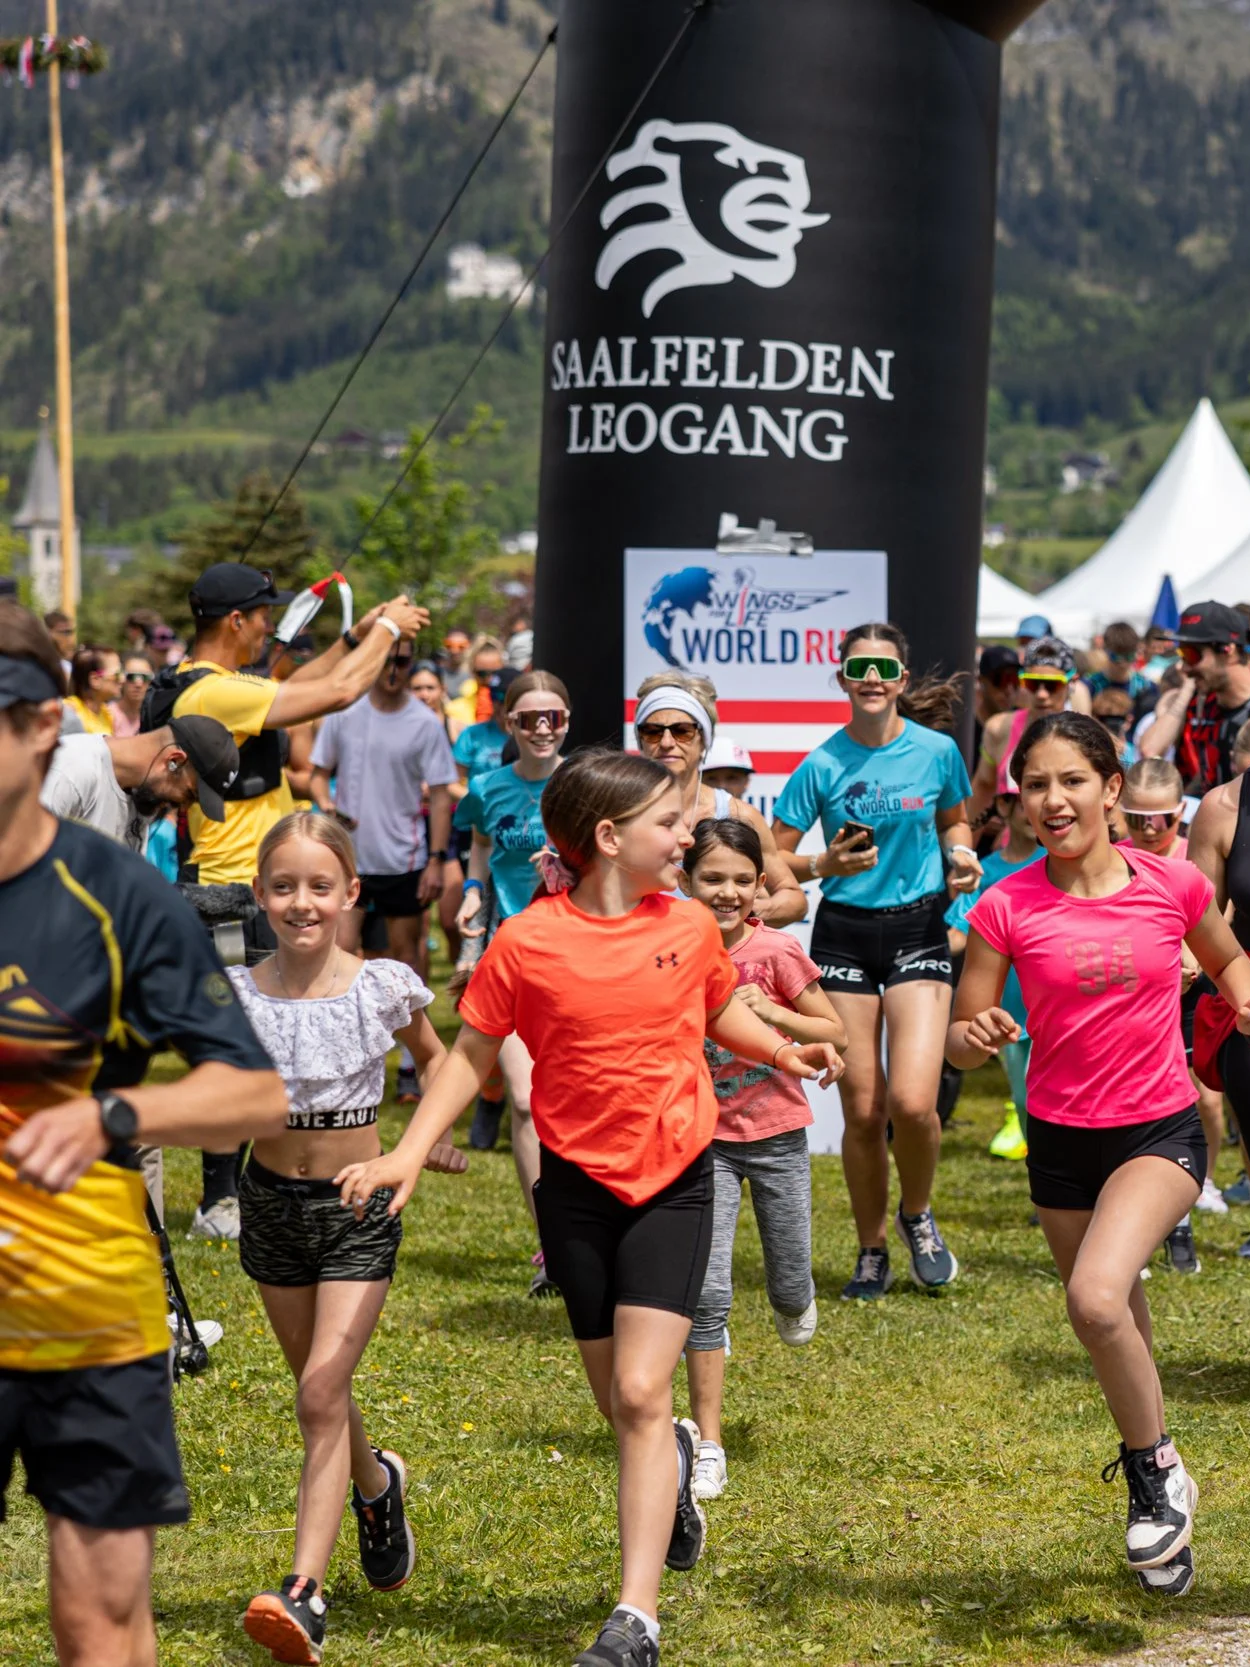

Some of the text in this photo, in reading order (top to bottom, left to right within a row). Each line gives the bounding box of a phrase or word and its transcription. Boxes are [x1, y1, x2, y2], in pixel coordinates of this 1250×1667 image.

[551, 336, 895, 400] SAALFELDEN
[566, 402, 849, 462] LEOGANG
[713, 592, 796, 611] WINGS
[725, 609, 769, 627] LIFE
[682, 628, 847, 665] WORLD RU
[860, 797, 901, 815] WORLD
[901, 797, 924, 810] RUN
[820, 964, 863, 982] IKE
[900, 959, 952, 974] PRO
